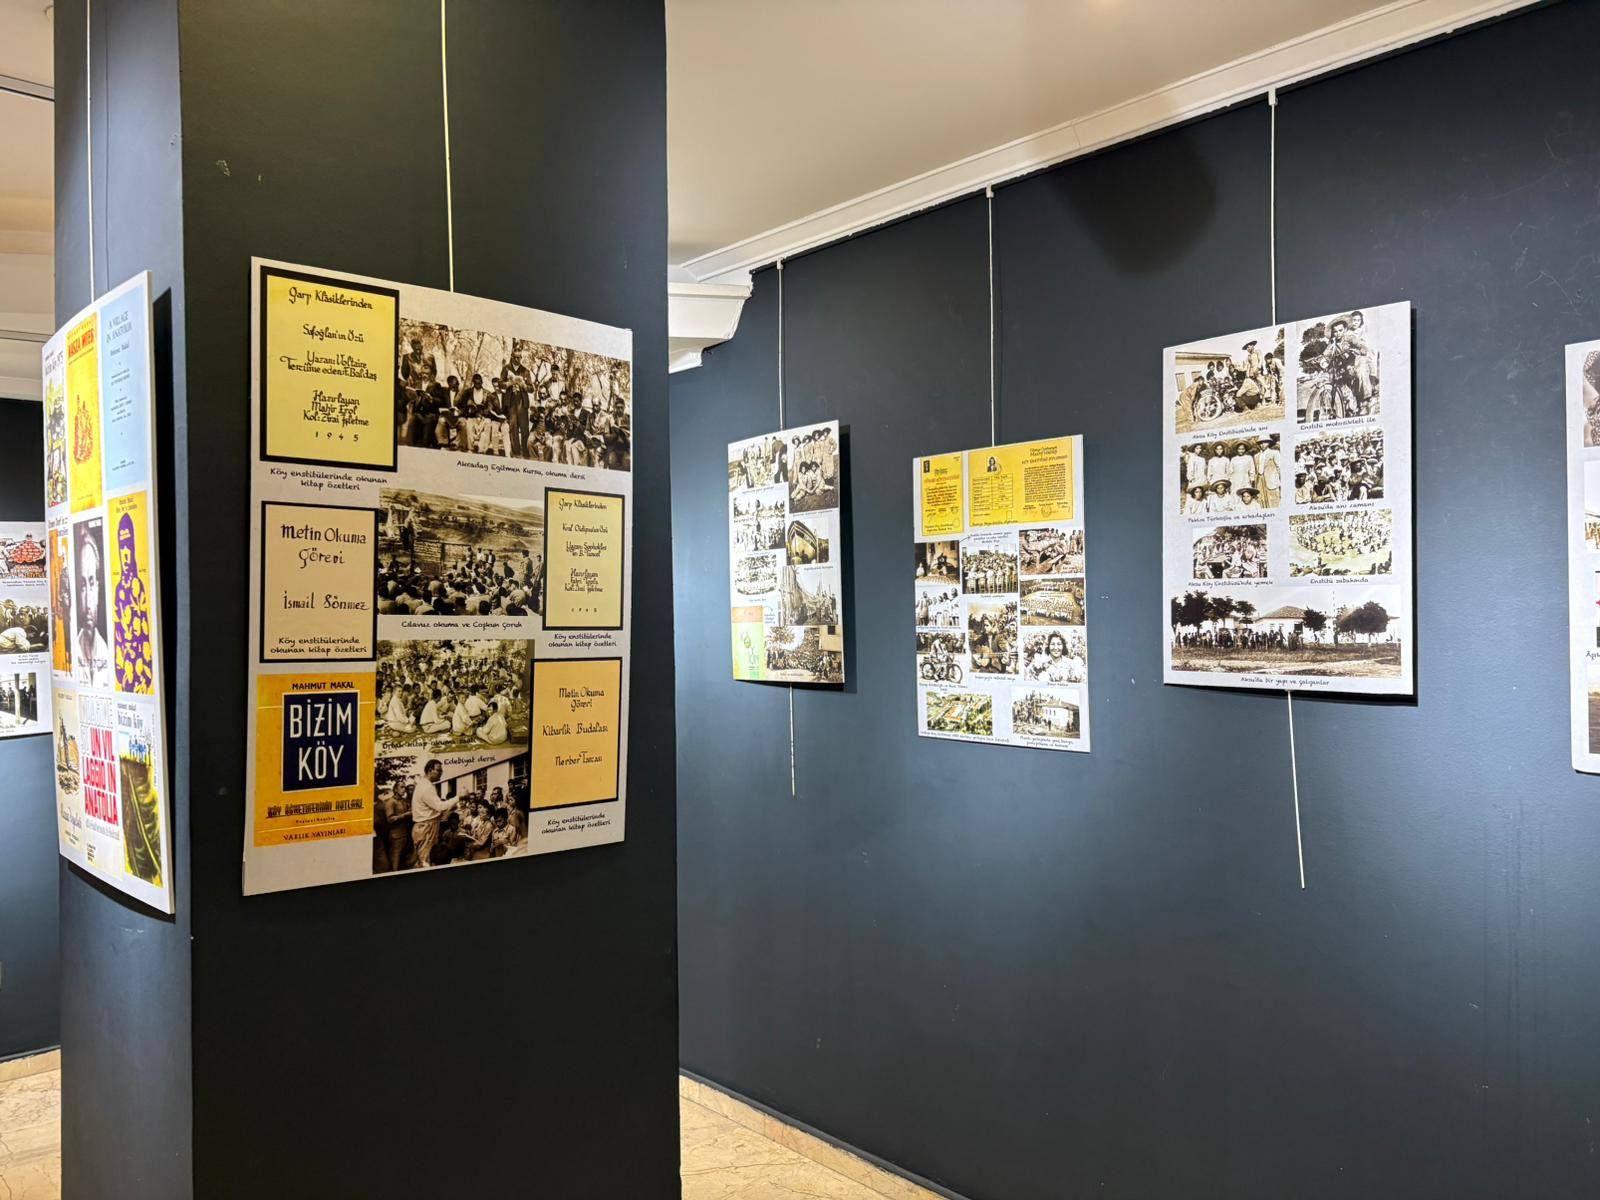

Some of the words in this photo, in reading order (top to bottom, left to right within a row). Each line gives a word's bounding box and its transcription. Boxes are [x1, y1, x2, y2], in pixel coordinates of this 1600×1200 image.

[270, 467, 289, 479] Köy
[290, 469, 354, 481] enstitülerinde
[355, 474, 389, 484] okunan
[300, 479, 325, 492] kitap
[326, 481, 361, 491] özetleri
[280, 523, 322, 542] Metin
[323, 527, 367, 545] Okuma
[461, 621, 472, 629] ve
[278, 636, 297, 648] Köy
[298, 636, 361, 645] enstitülerinde
[270, 646, 305, 655] okunan
[307, 646, 332, 657] kitap
[334, 645, 368, 654] özetleri
[291, 682, 327, 691] MAHMUT
[330, 681, 356, 690] MAKAL
[289, 698, 353, 739] BİZİM
[298, 740, 345, 782] KÖY
